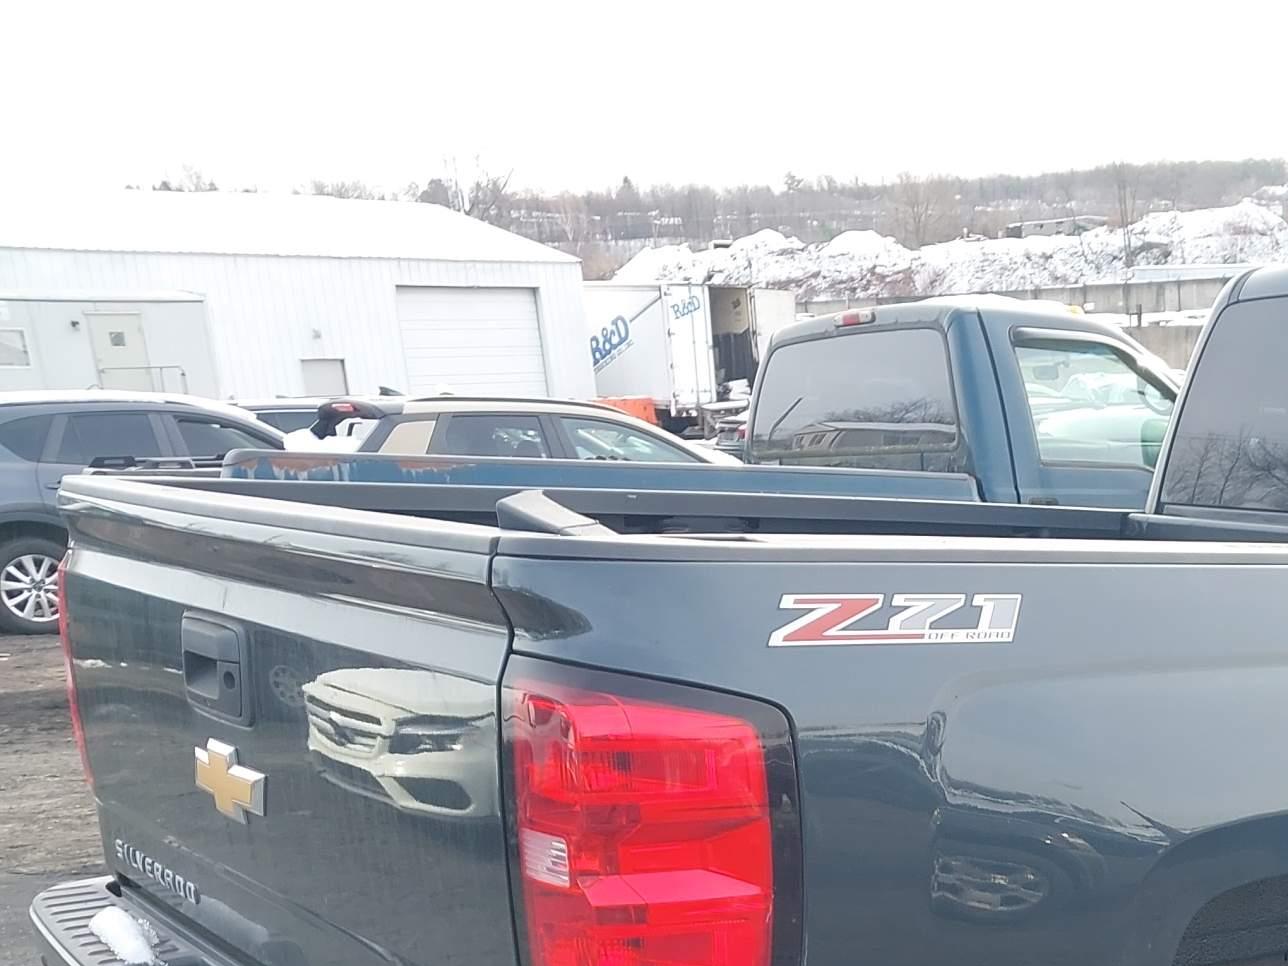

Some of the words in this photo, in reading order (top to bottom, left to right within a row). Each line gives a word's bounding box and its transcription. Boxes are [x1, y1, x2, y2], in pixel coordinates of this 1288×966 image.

[670, 295, 702, 320] R&D
[589, 315, 630, 368] R&D
[767, 593, 1023, 648] Z71
[926, 631, 958, 641] OFF
[965, 629, 1011, 641] ROAD
[114, 838, 198, 905] SILVERADO
